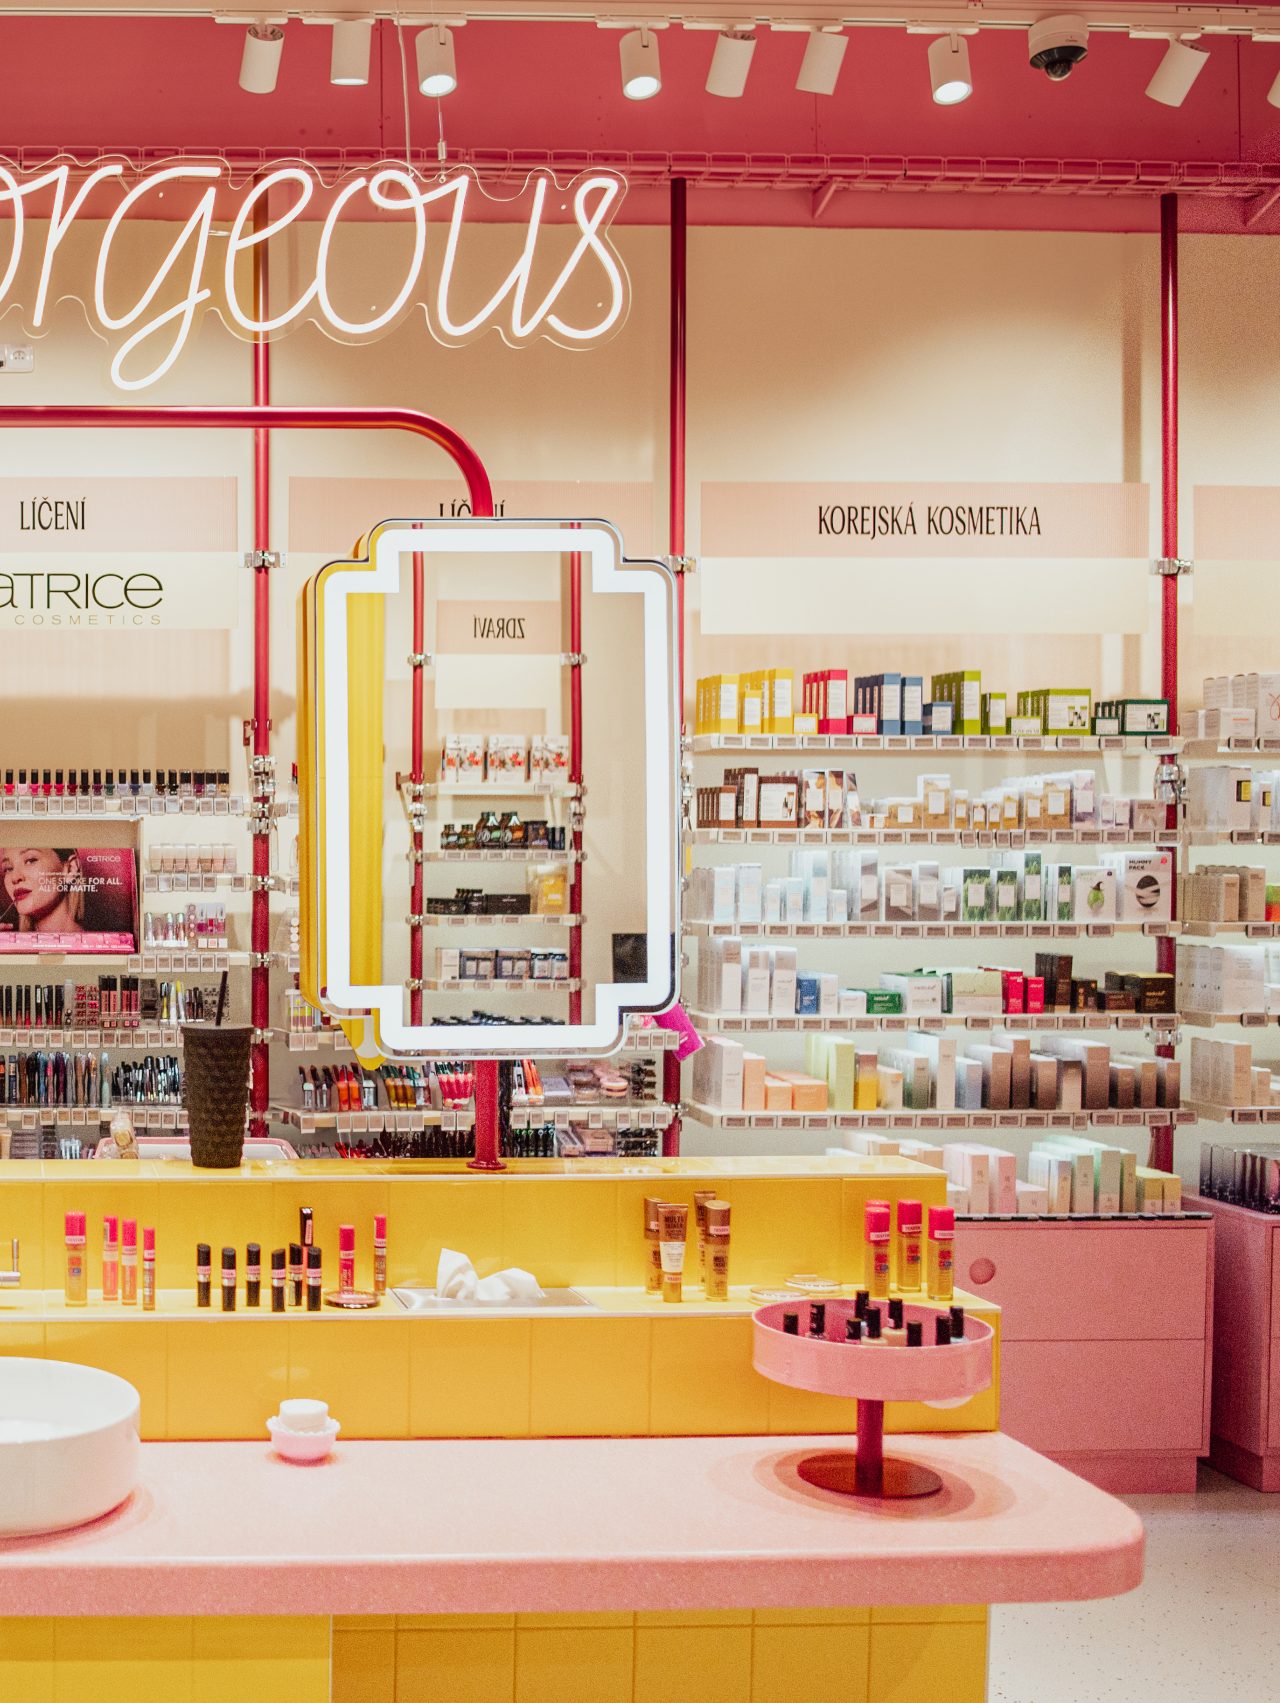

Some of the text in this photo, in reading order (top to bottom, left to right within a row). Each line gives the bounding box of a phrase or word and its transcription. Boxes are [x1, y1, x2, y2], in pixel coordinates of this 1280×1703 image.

[20, 496, 87, 531] LÍČENÍ
[818, 501, 1042, 541] KOREJSKÁ KOSMETIKA
[14, 614, 162, 626] COSMETICS
[58, 877, 87, 885] STROKE
[88, 877, 105, 885] FOR
[106, 877, 123, 885] ALL.
[70, 884, 98, 892] MATTE.
